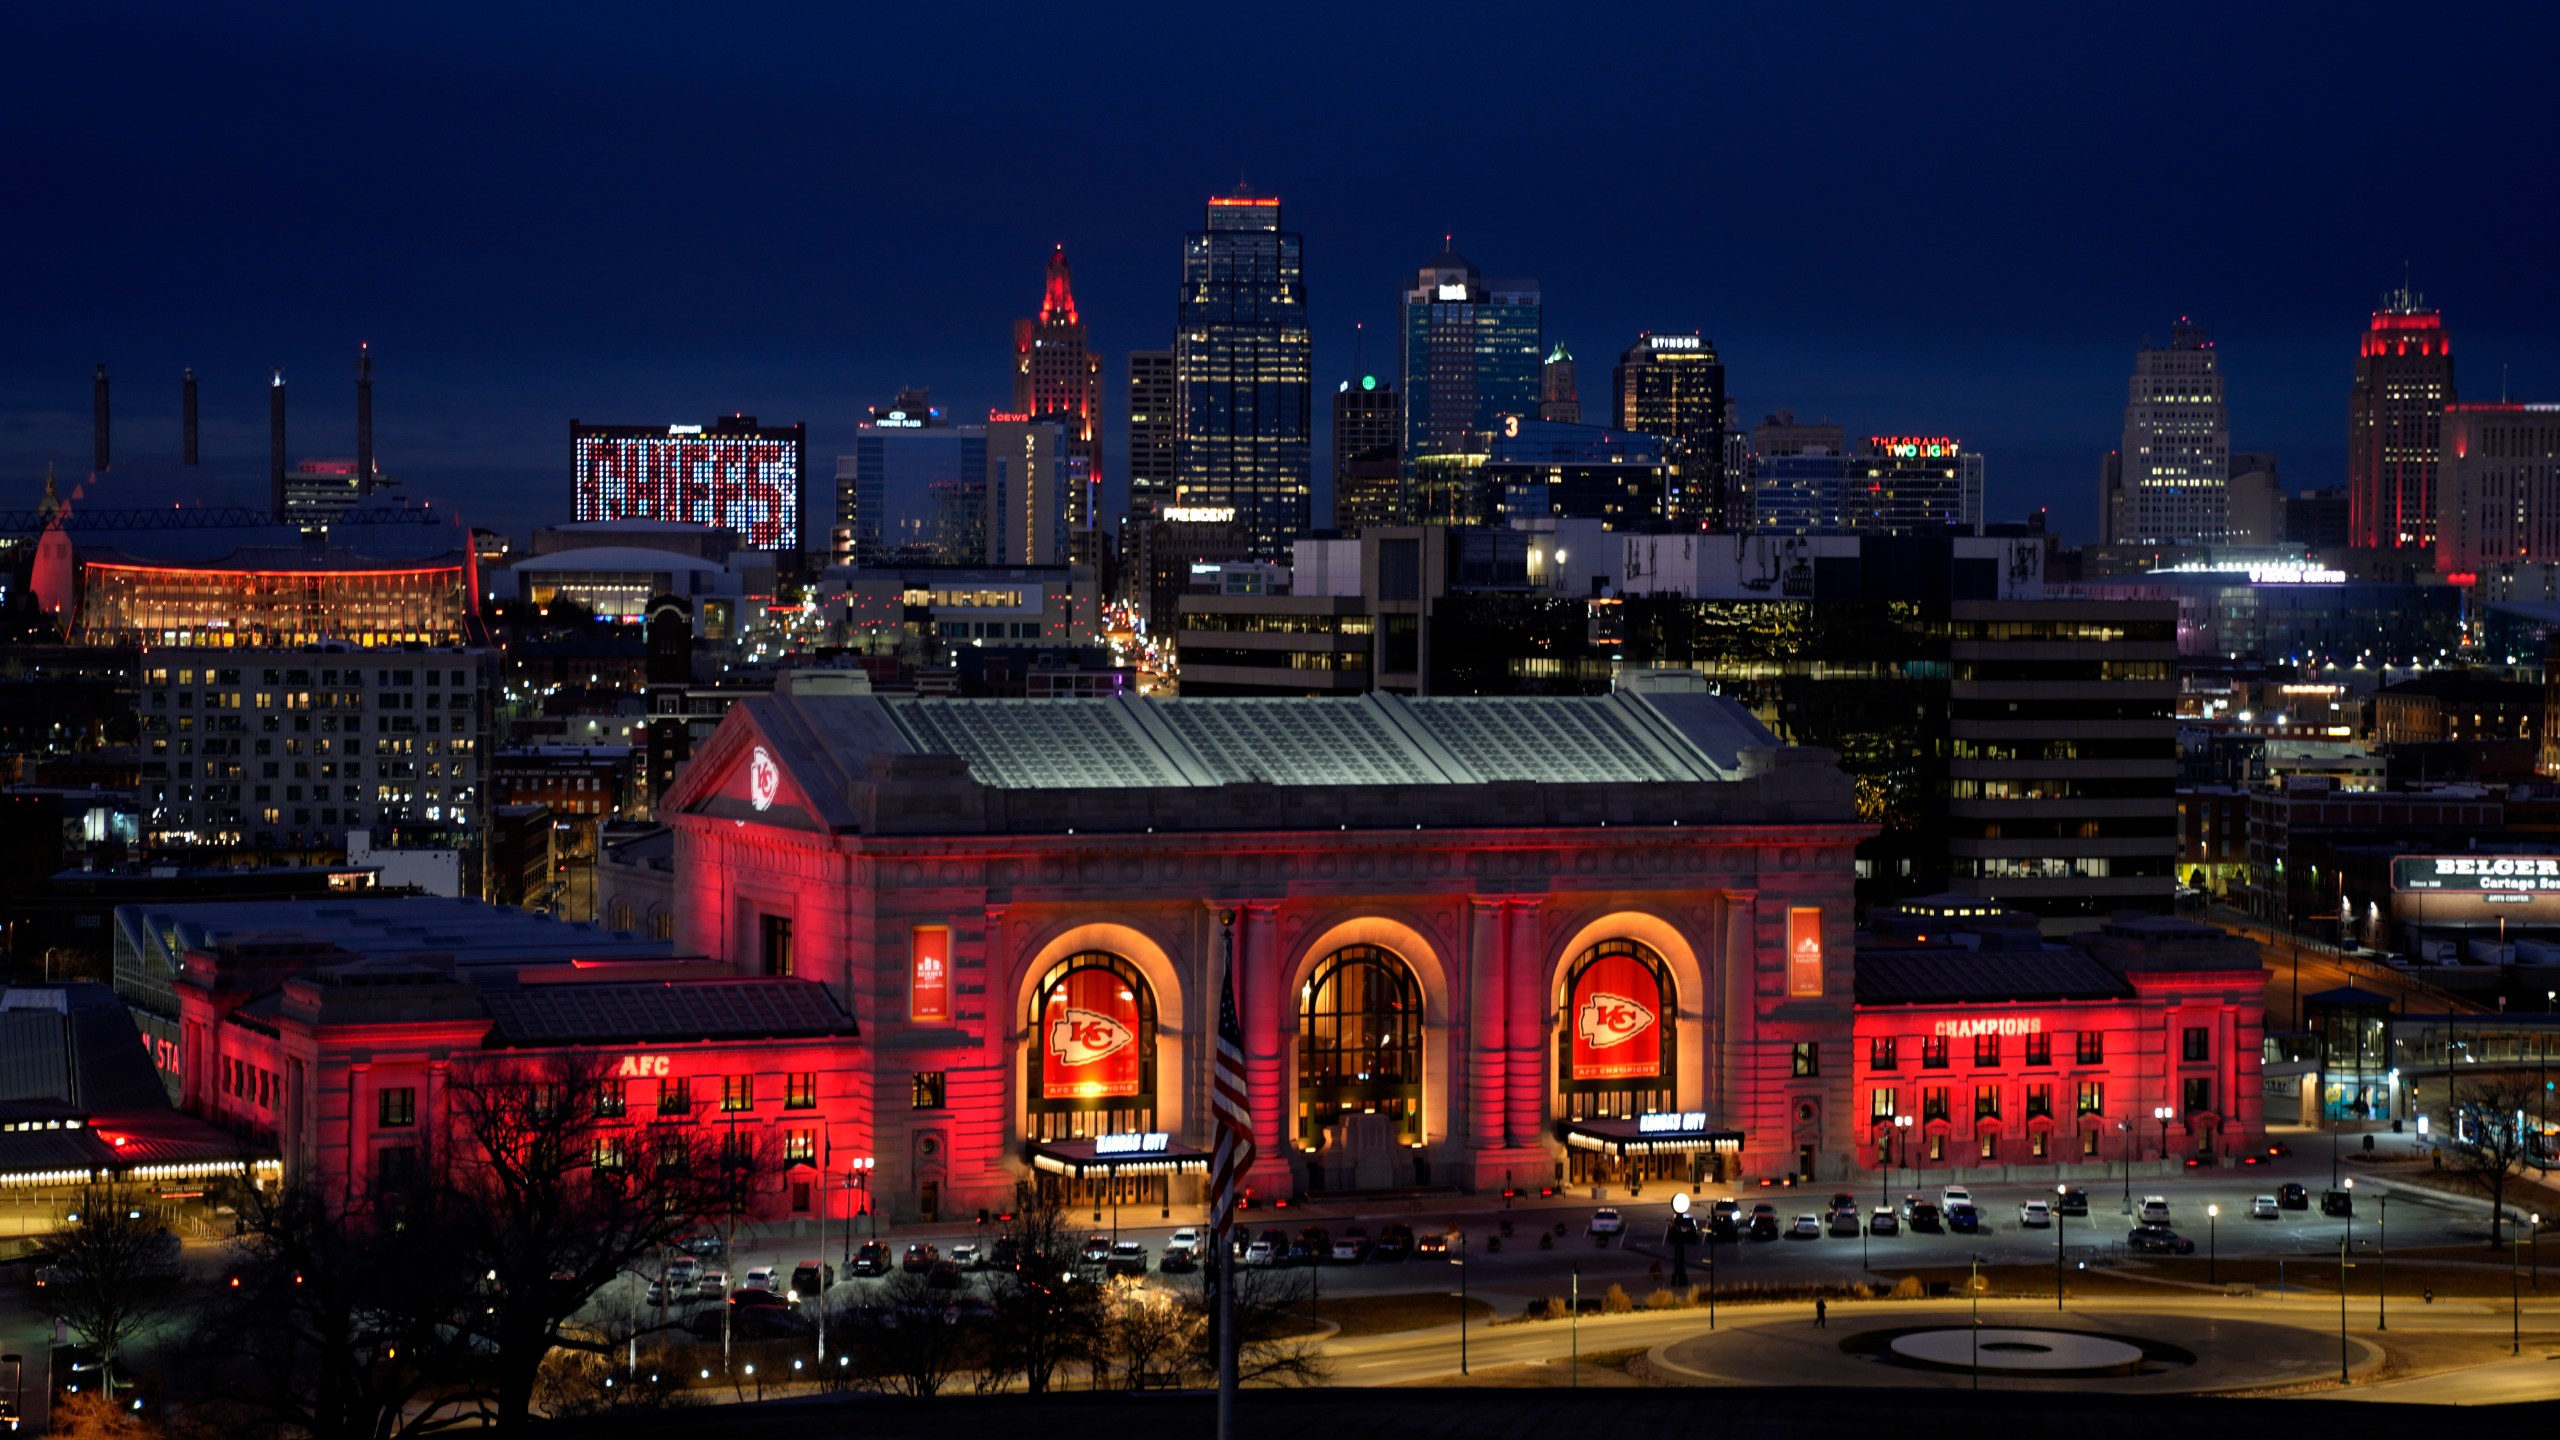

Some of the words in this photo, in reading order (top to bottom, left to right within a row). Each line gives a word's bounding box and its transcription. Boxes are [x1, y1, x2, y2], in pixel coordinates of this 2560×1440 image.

[1651, 337, 1700, 348] STINSON
[902, 419, 922, 428] PLAZA
[989, 413, 1029, 422] LOEWS
[1505, 416, 1518, 438] 3
[1901, 435, 1950, 446] GRAND
[1886, 443, 1918, 458] TWO
[1919, 443, 1959, 458] LIGHT
[1163, 507, 1236, 522] PRESIDENT
[2435, 858, 2560, 876] BELGER
[2409, 880, 2428, 888] Since
[2479, 877, 2536, 891] Cartage
[2487, 894, 2505, 903] ARTS
[2505, 894, 2530, 903] CENTER
[1597, 1004, 1636, 1034] KC
[1935, 1017, 2042, 1038] CHAMPIONS
[1069, 1021, 1113, 1051] KC
[619, 1055, 670, 1077] AFC
[1578, 1068, 1597, 1076] AFC
[1599, 1065, 1656, 1076] CHAMPIONS
[1682, 1111, 1707, 1131] CITY
[1142, 1132, 1169, 1151] CITY
